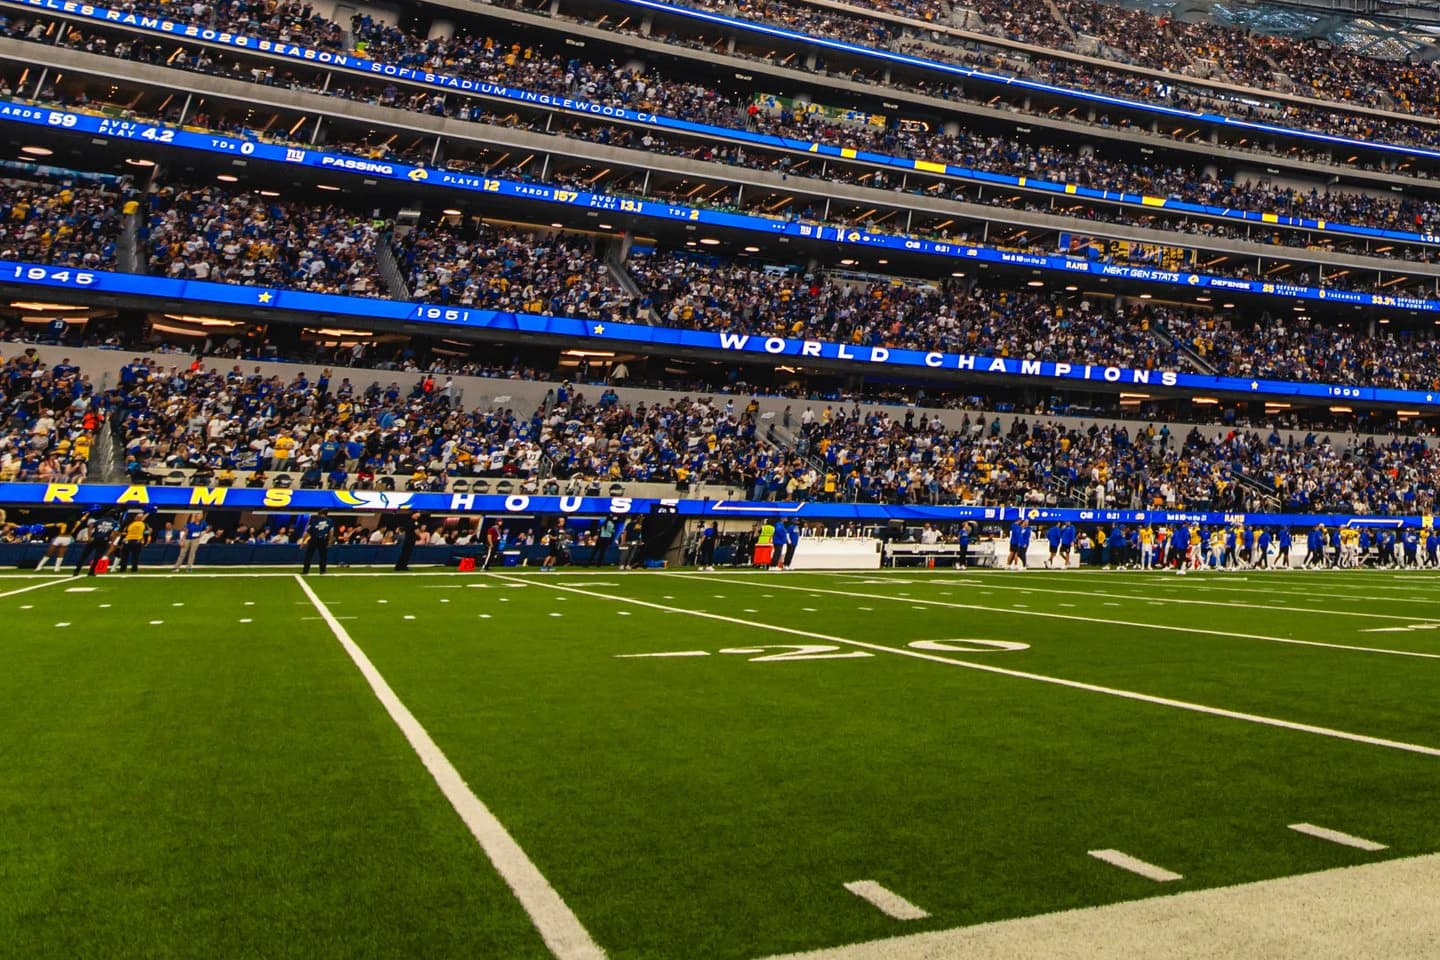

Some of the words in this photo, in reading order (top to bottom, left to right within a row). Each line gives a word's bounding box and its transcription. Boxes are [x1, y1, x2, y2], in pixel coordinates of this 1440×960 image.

[106, 10, 175, 32] RAMS
[185, 26, 248, 46] 2026
[258, 41, 348, 66] SEASON
[371, 62, 418, 80] SOFI
[637, 111, 659, 125] CA
[48, 112, 78, 128] 59
[99, 127, 136, 138] PLAY
[141, 127, 175, 142] 4.2
[240, 142, 255, 155] 0
[321, 156, 394, 175] PASSING
[443, 176, 480, 187] PLAYS
[483, 178, 501, 192] 12
[515, 186, 550, 198] YARDS
[553, 190, 579, 203] 157
[620, 199, 643, 213] 13.1
[689, 209, 700, 221] 2
[1420, 234, 1440, 243] LOS
[13, 266, 95, 285] 1945
[1102, 266, 1130, 277] NEXT
[1130, 269, 1150, 279] GEN
[1151, 271, 1180, 282] STATS
[1211, 279, 1250, 290] DEFENSE
[416, 306, 470, 321] 1951
[719, 332, 890, 363] WORLD
[925, 352, 1178, 387] CHAMPIONS
[44, 483, 294, 507] RAMS
